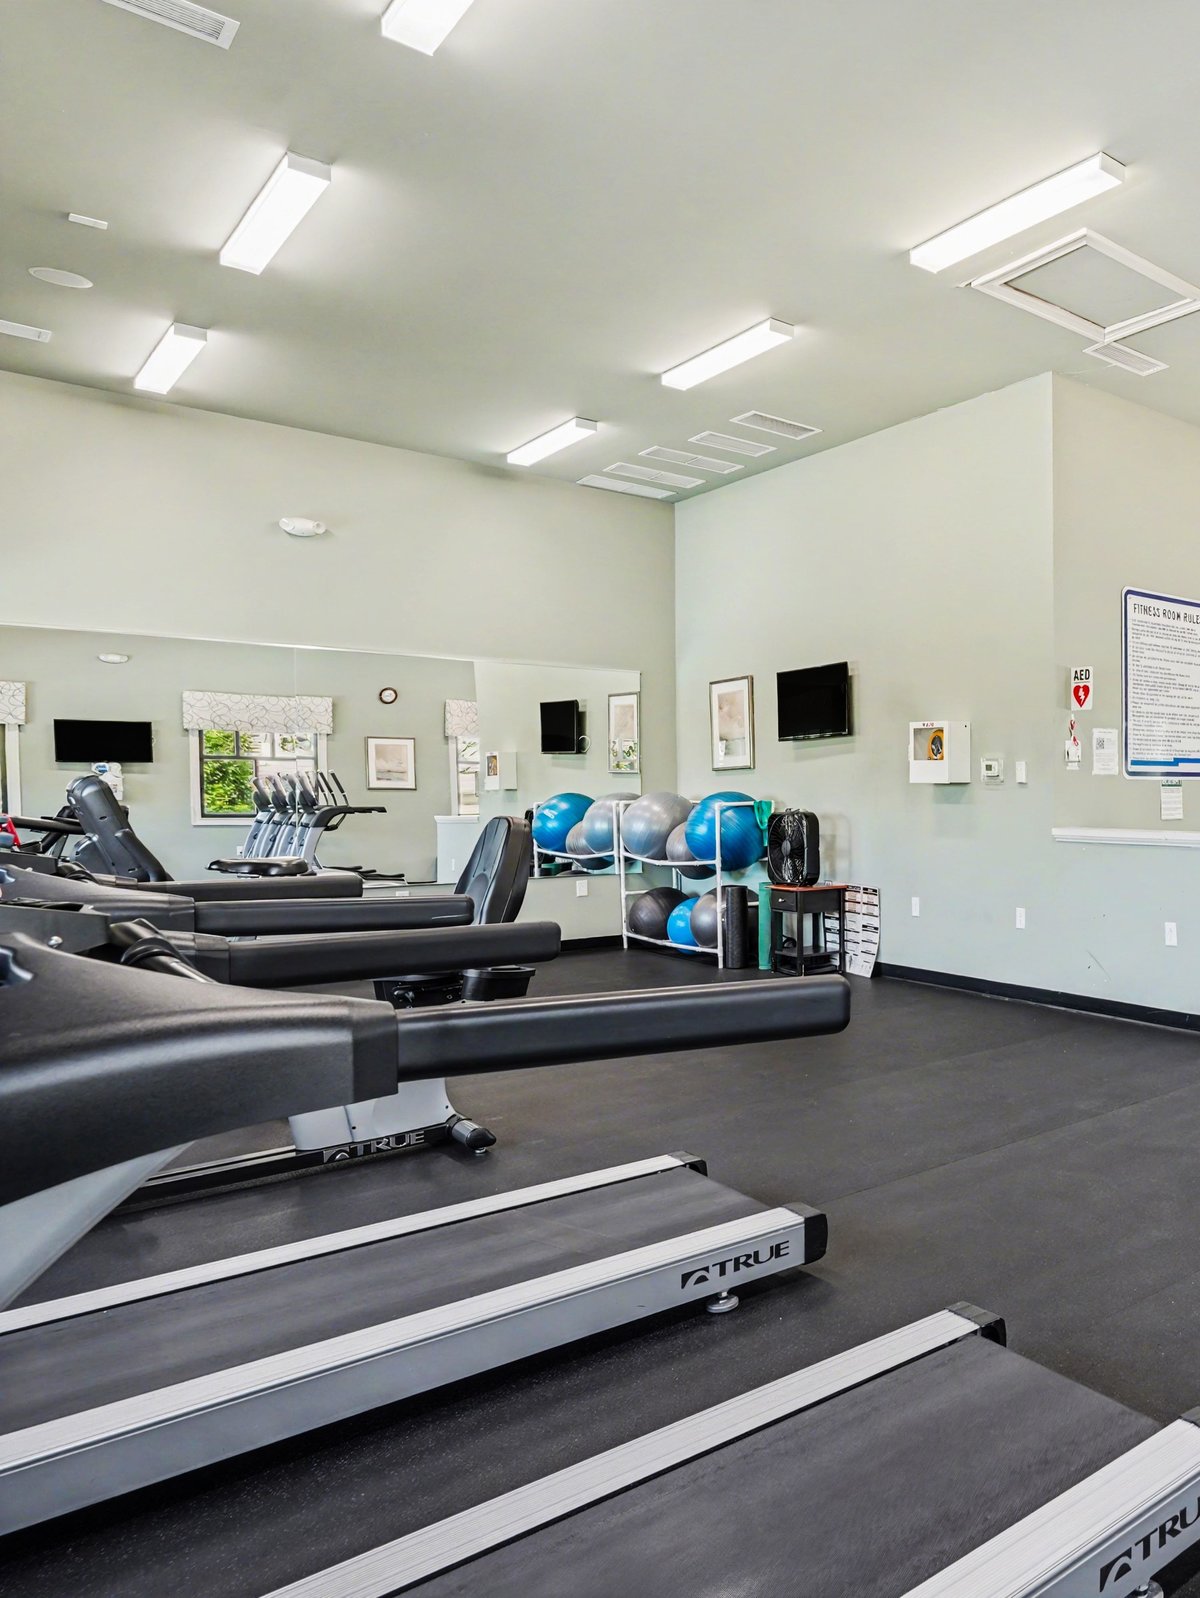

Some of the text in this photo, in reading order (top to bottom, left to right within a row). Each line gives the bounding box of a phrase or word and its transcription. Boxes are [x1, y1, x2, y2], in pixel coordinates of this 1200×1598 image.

[1133, 603, 1160, 618] FITNESS
[1163, 608, 1181, 621] ROOM
[1073, 668, 1090, 681] AED
[350, 1130, 425, 1156] TRUE
[712, 1240, 790, 1277] TRUE
